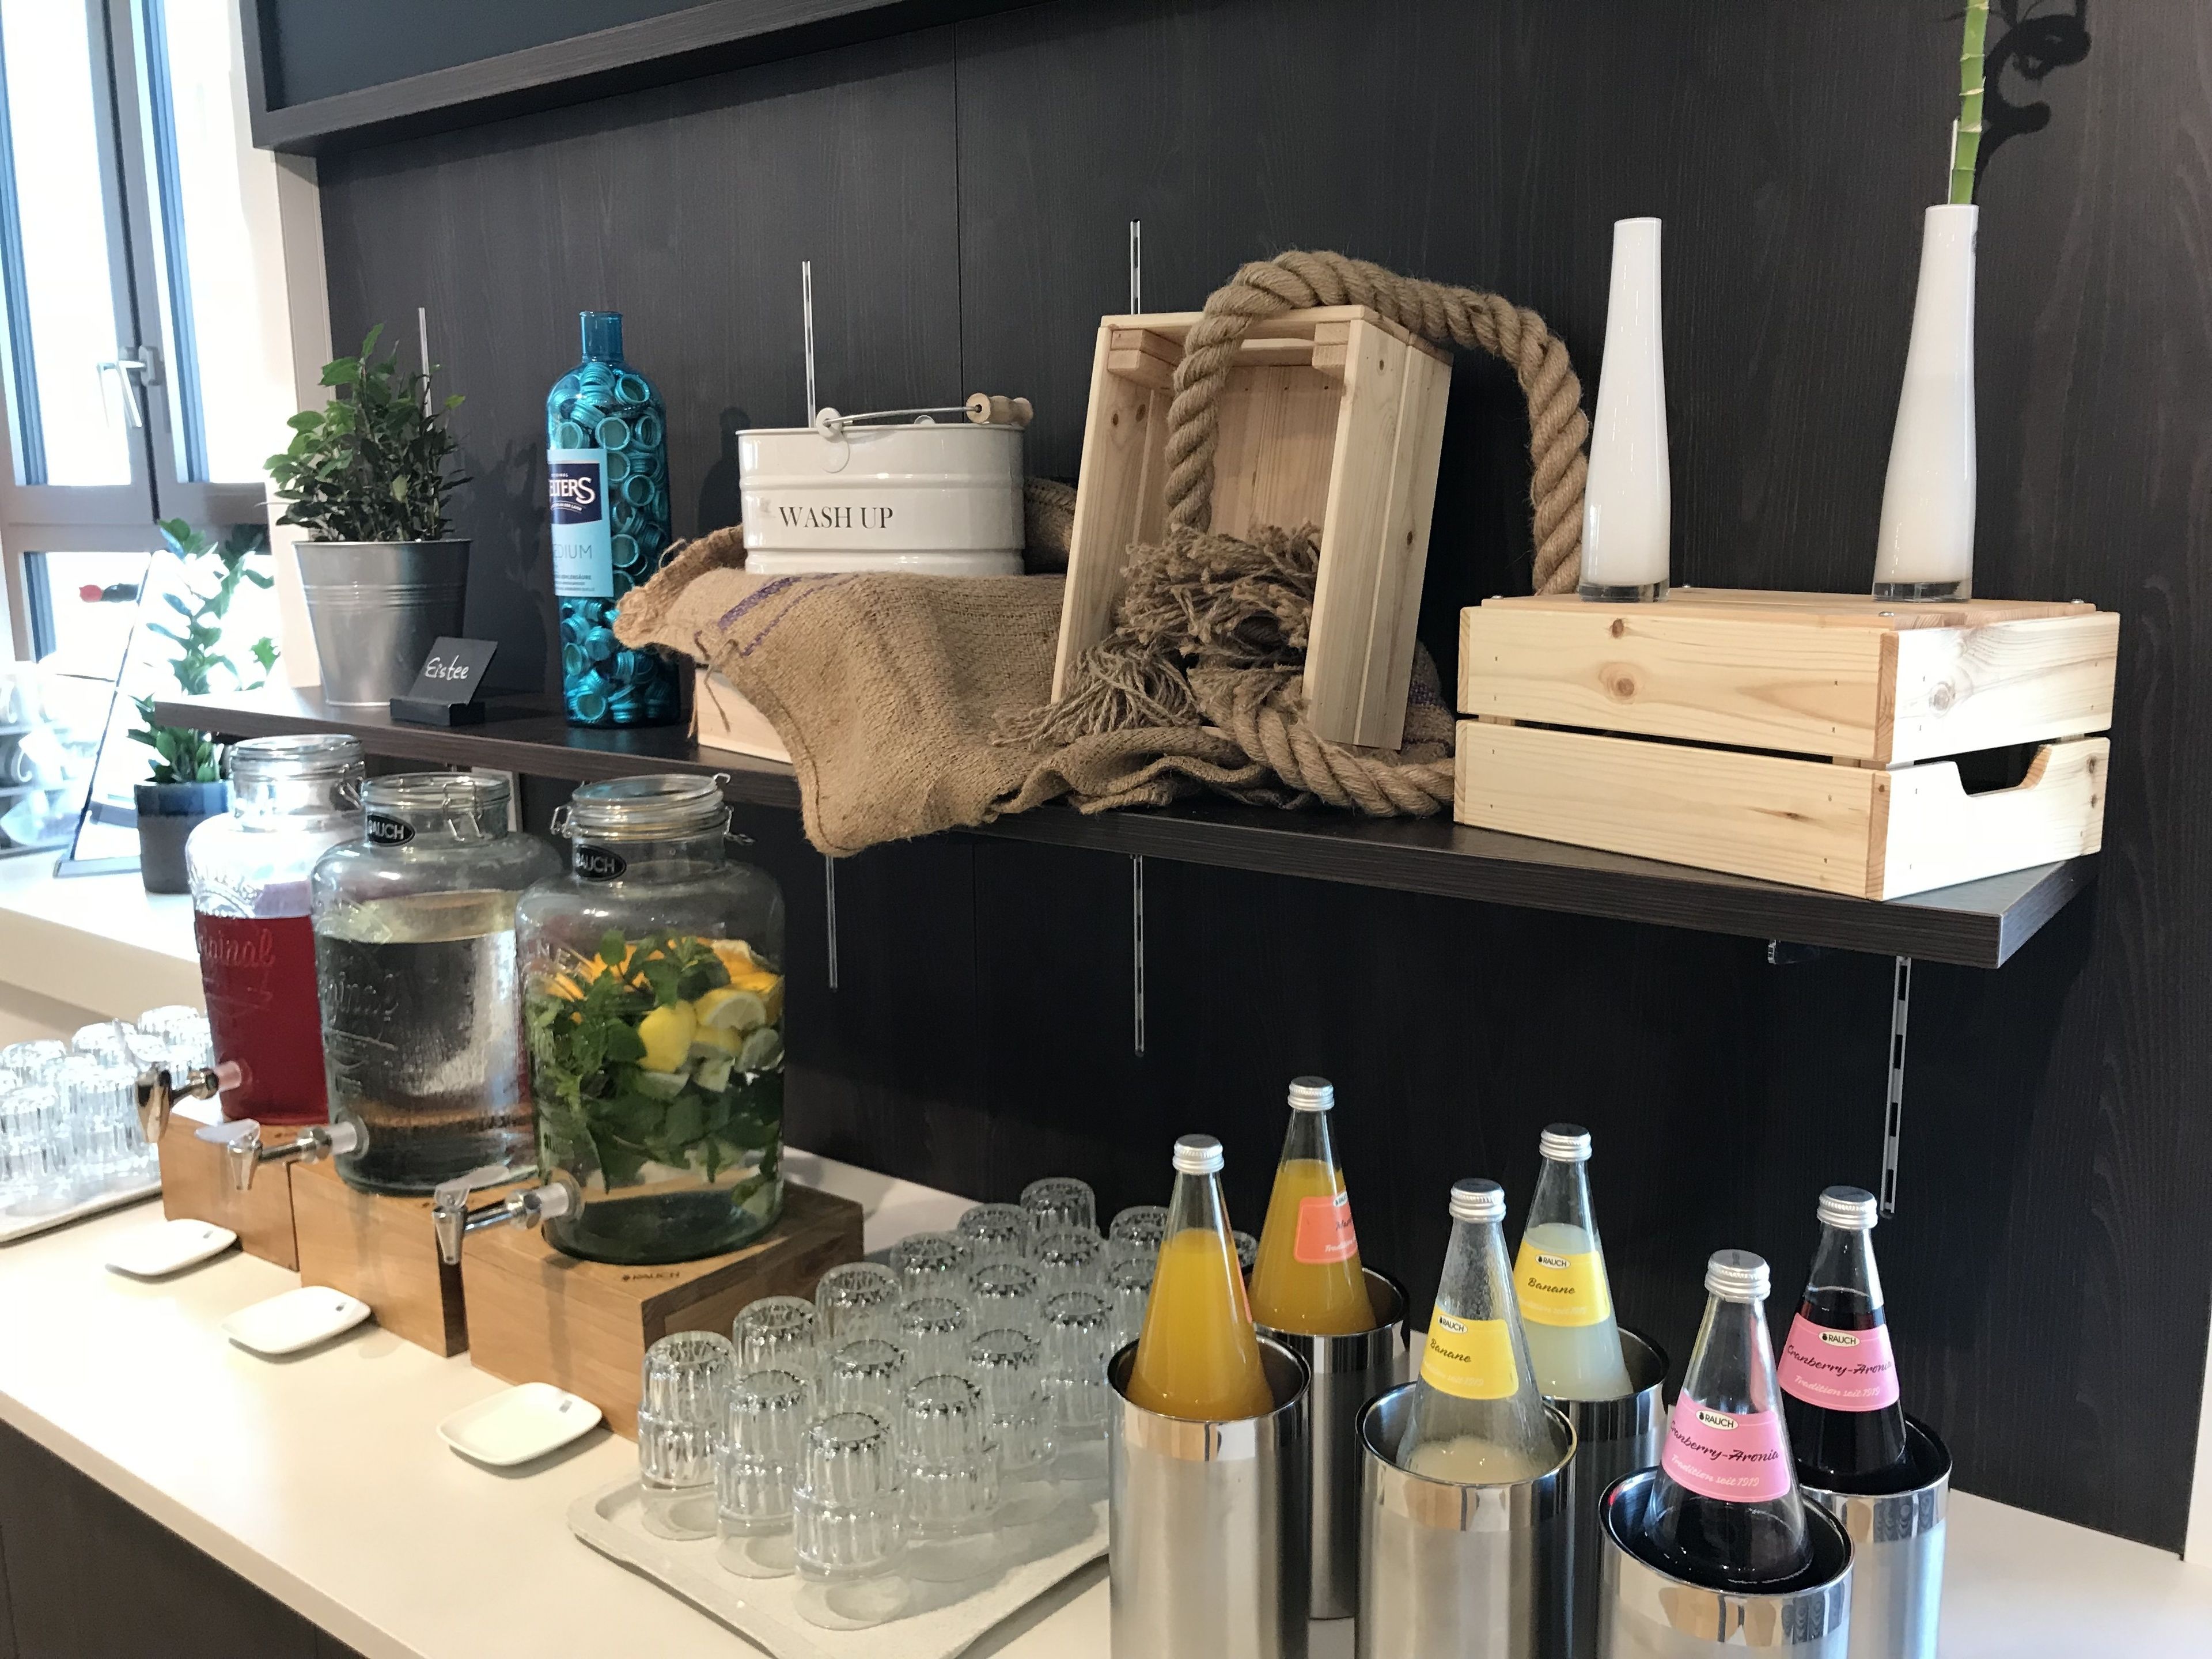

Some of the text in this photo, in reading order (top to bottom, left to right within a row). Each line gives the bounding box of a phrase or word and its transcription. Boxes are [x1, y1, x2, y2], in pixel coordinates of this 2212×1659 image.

[779, 506, 893, 529] WASH UP
[425, 654, 469, 680] Eistee
[1543, 1256, 1567, 1267] RAUCH
[1528, 1277, 1575, 1295] Banane
[1442, 1317, 1464, 1332] RAUCH
[1430, 1338, 1472, 1363] Banane
[1828, 1335, 1856, 1345] RAUCH
[1787, 1344, 1892, 1377] Cranberry-Aronia
[1794, 1375, 1841, 1396] Tradition
[1843, 1388, 1862, 1397] seit
[1705, 1414, 1734, 1429] RAUCH
[1671, 1453, 1760, 1487] Tradition seit 1919
